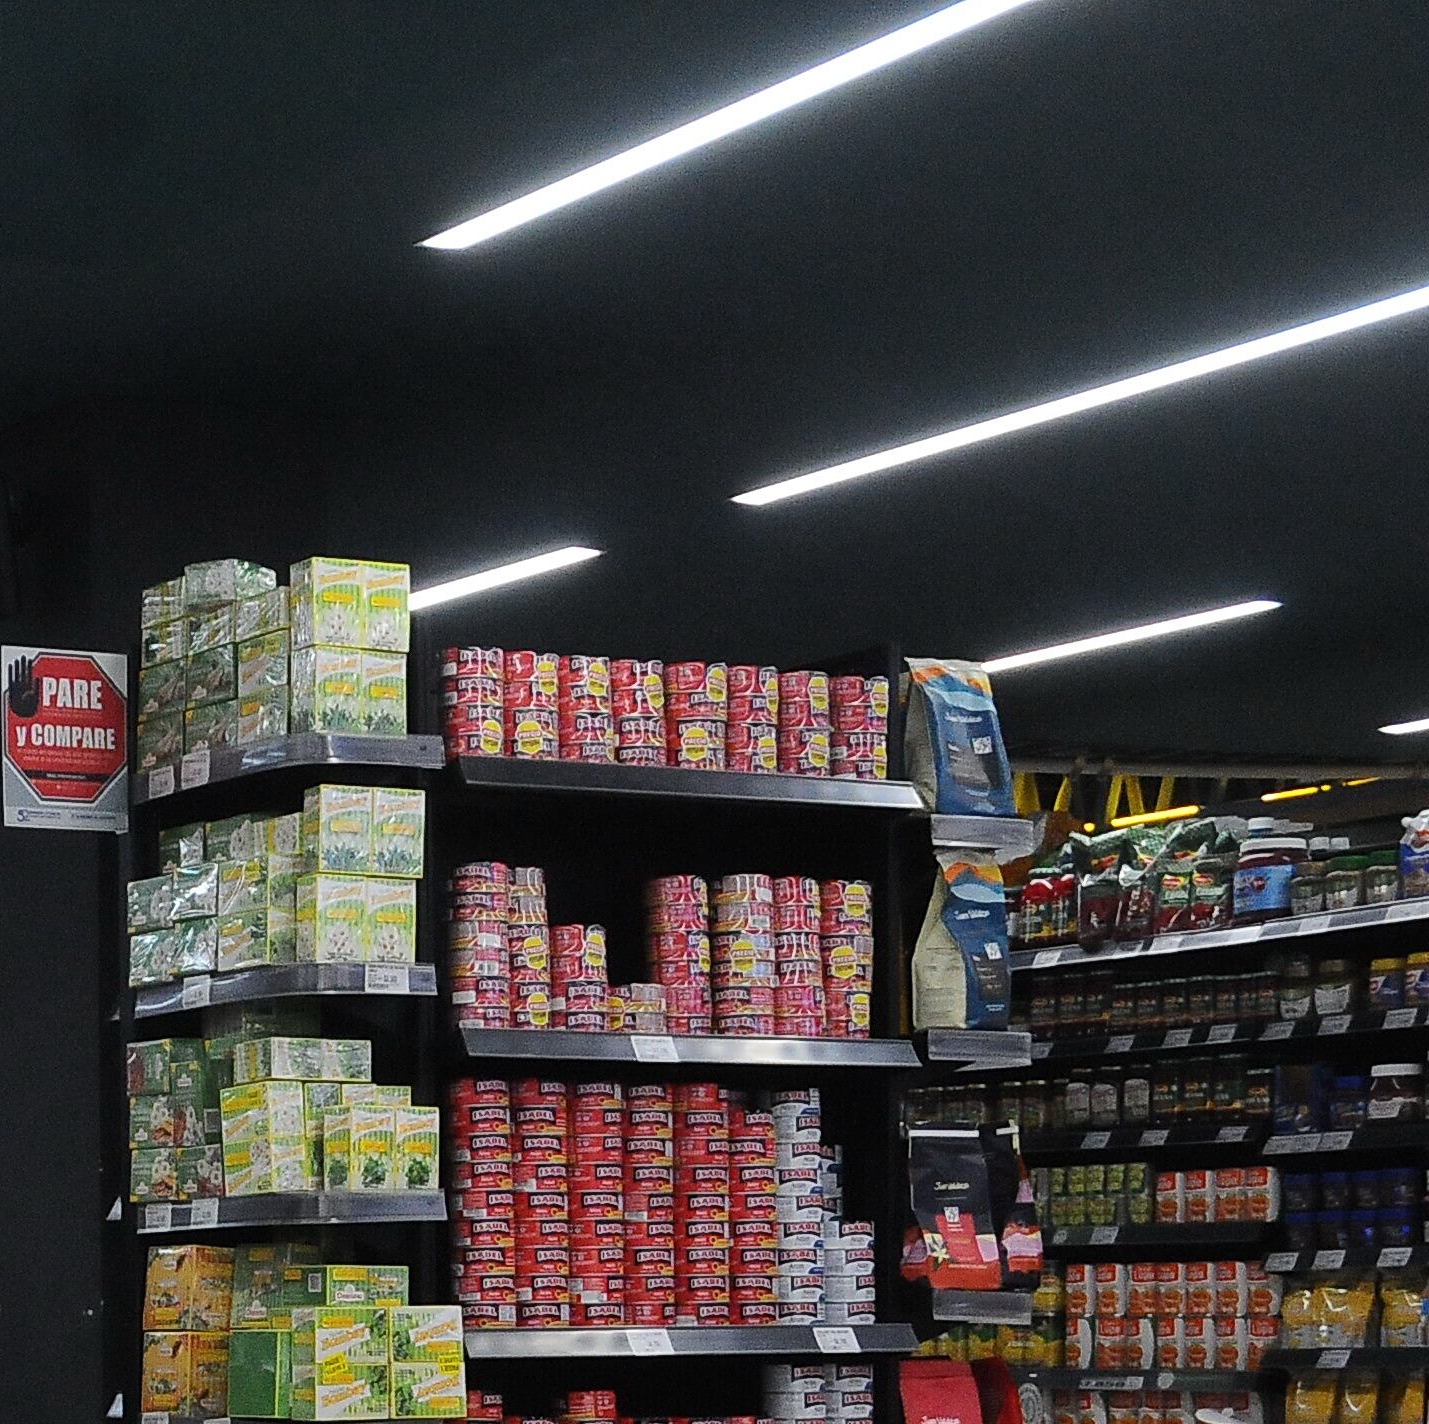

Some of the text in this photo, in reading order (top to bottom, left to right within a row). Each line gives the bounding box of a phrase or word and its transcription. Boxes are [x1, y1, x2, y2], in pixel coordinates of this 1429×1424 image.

[43, 678, 102, 710] PARE
[16, 723, 116, 750] y COMPARE
[577, 1084, 614, 1095] ISABEL
[628, 1085, 665, 1097] ISABEL
[517, 1109, 555, 1121] ISABEL
[688, 1113, 724, 1124] ISABEL
[524, 1137, 561, 1149] ISABEL
[729, 1141, 765, 1153] ISABEL
[474, 1164, 509, 1175] ISABEL
[781, 1169, 817, 1180] ISABEL
[473, 1222, 509, 1233] ISABEL
[466, 1250, 504, 1262] ISABEL
[780, 1251, 817, 1262] ISABEL
[735, 1277, 772, 1289] ISABEL
[522, 1305, 560, 1317] ISABEL
